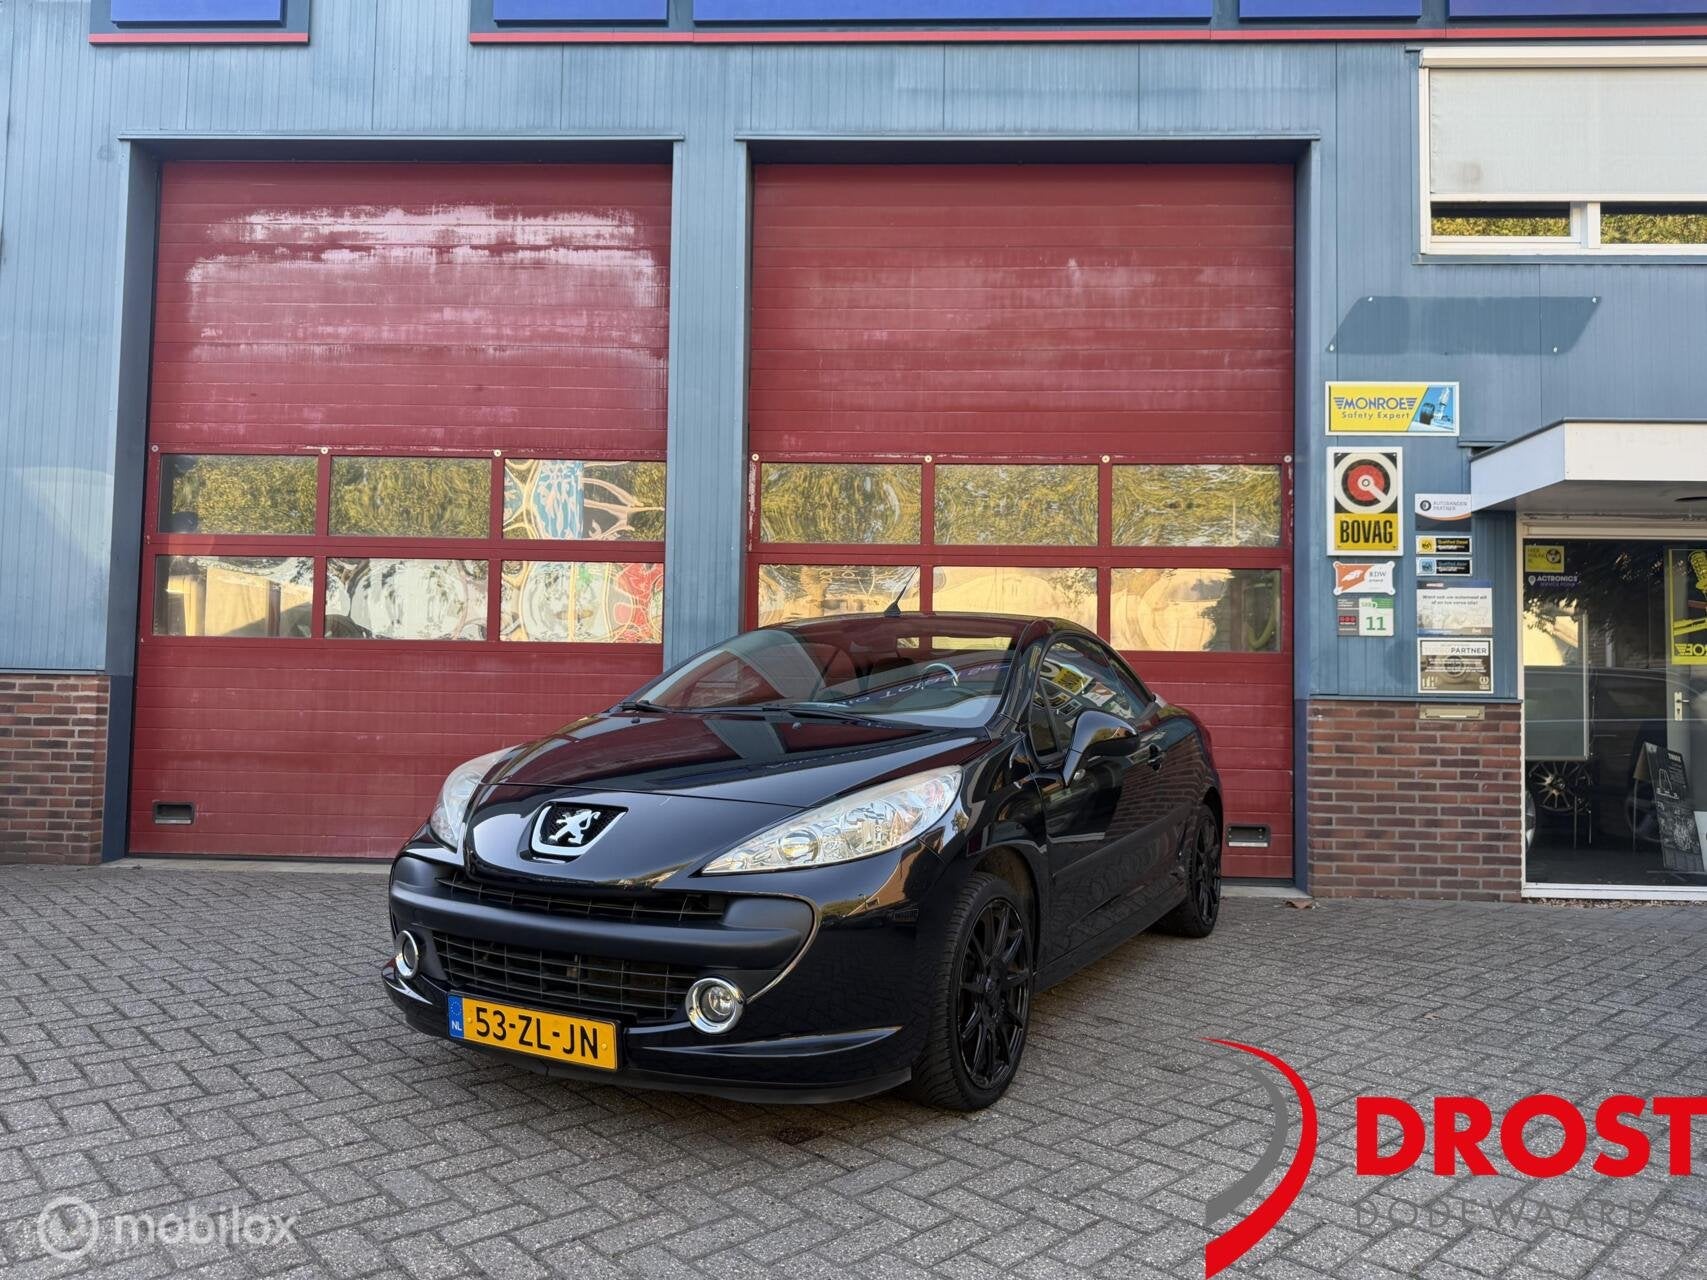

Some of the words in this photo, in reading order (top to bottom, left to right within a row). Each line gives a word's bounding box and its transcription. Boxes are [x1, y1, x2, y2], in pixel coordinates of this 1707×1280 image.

[1343, 397, 1408, 410] MONROE
[1342, 411, 1374, 421] Safety
[1377, 411, 1410, 420] Expert
[1340, 520, 1393, 544] BOVAG
[1366, 616, 1386, 631] 11
[451, 1021, 463, 1031] NL
[475, 1006, 599, 1060] 53-ZL-JN
